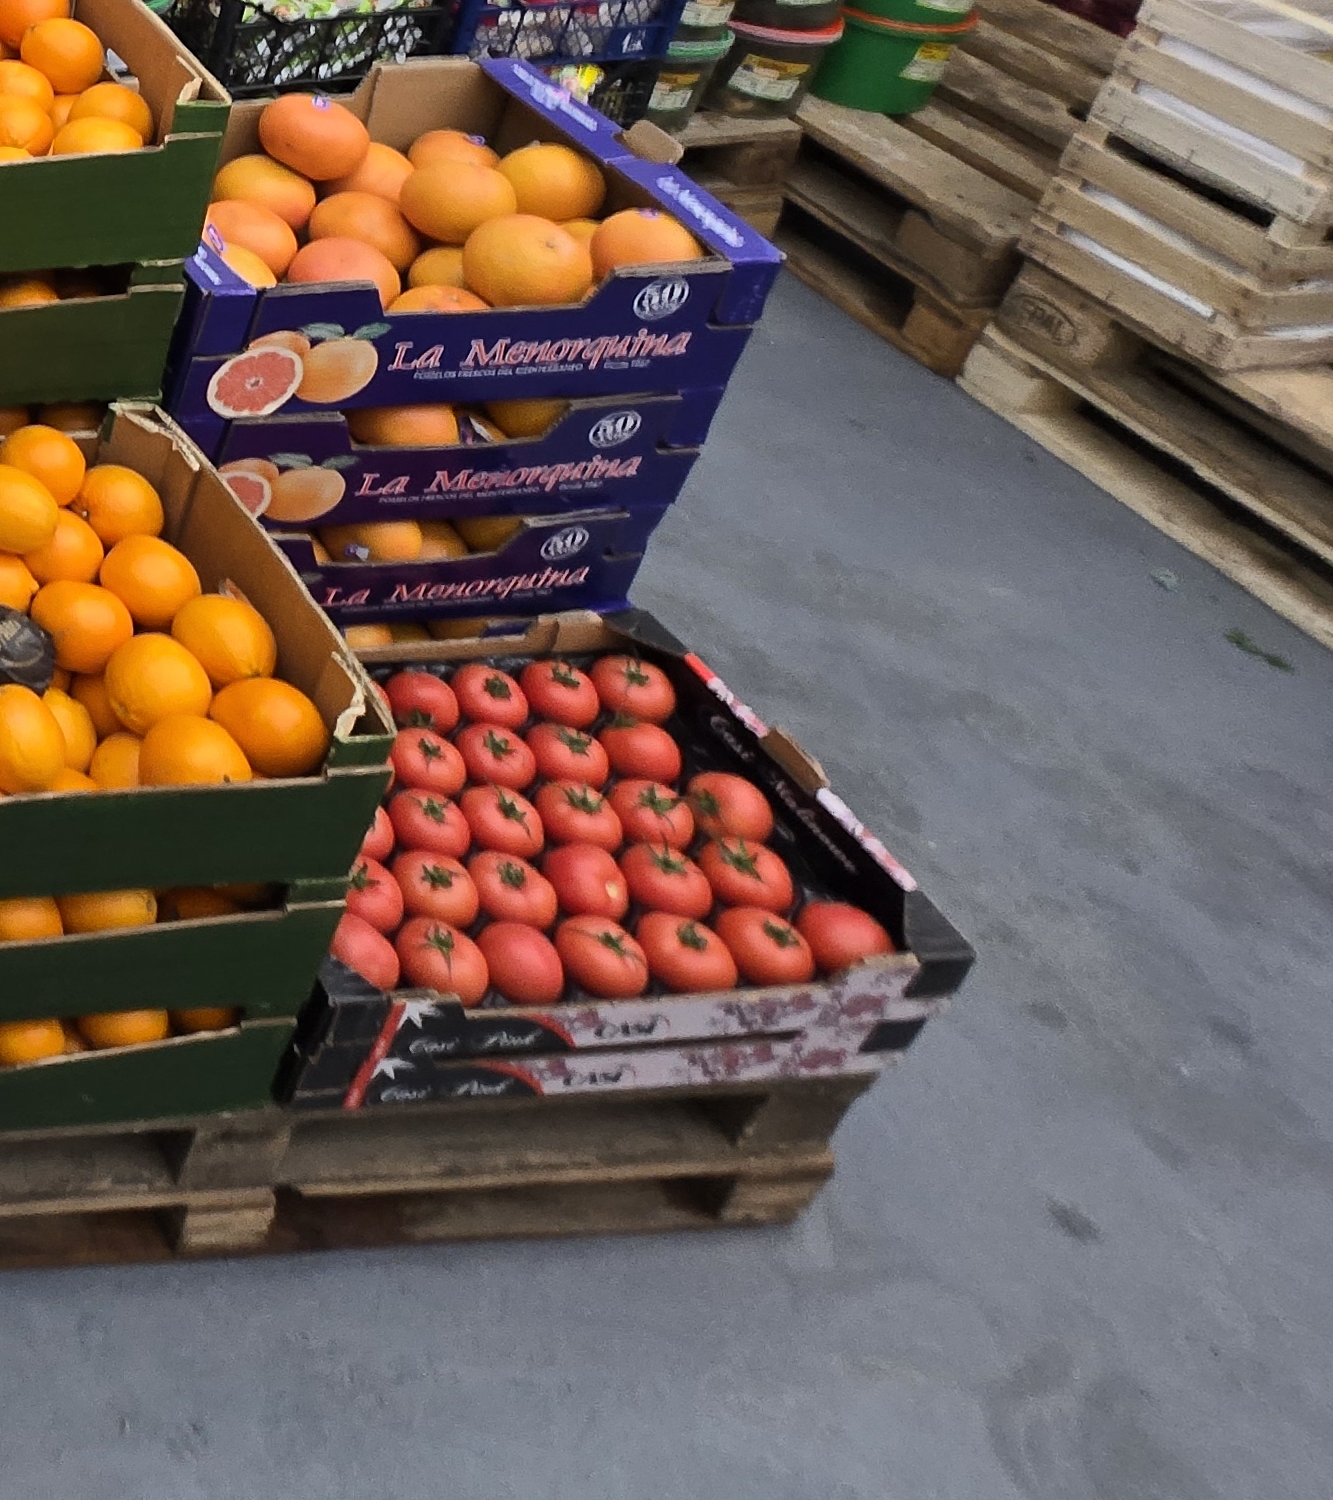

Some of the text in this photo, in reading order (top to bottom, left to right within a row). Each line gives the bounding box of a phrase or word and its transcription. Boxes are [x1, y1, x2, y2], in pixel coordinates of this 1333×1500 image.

[389, 328, 692, 371] La Menorquina
[355, 454, 643, 497] La Menorquina
[321, 586, 370, 607] La
[391, 566, 590, 601] Menorquina
